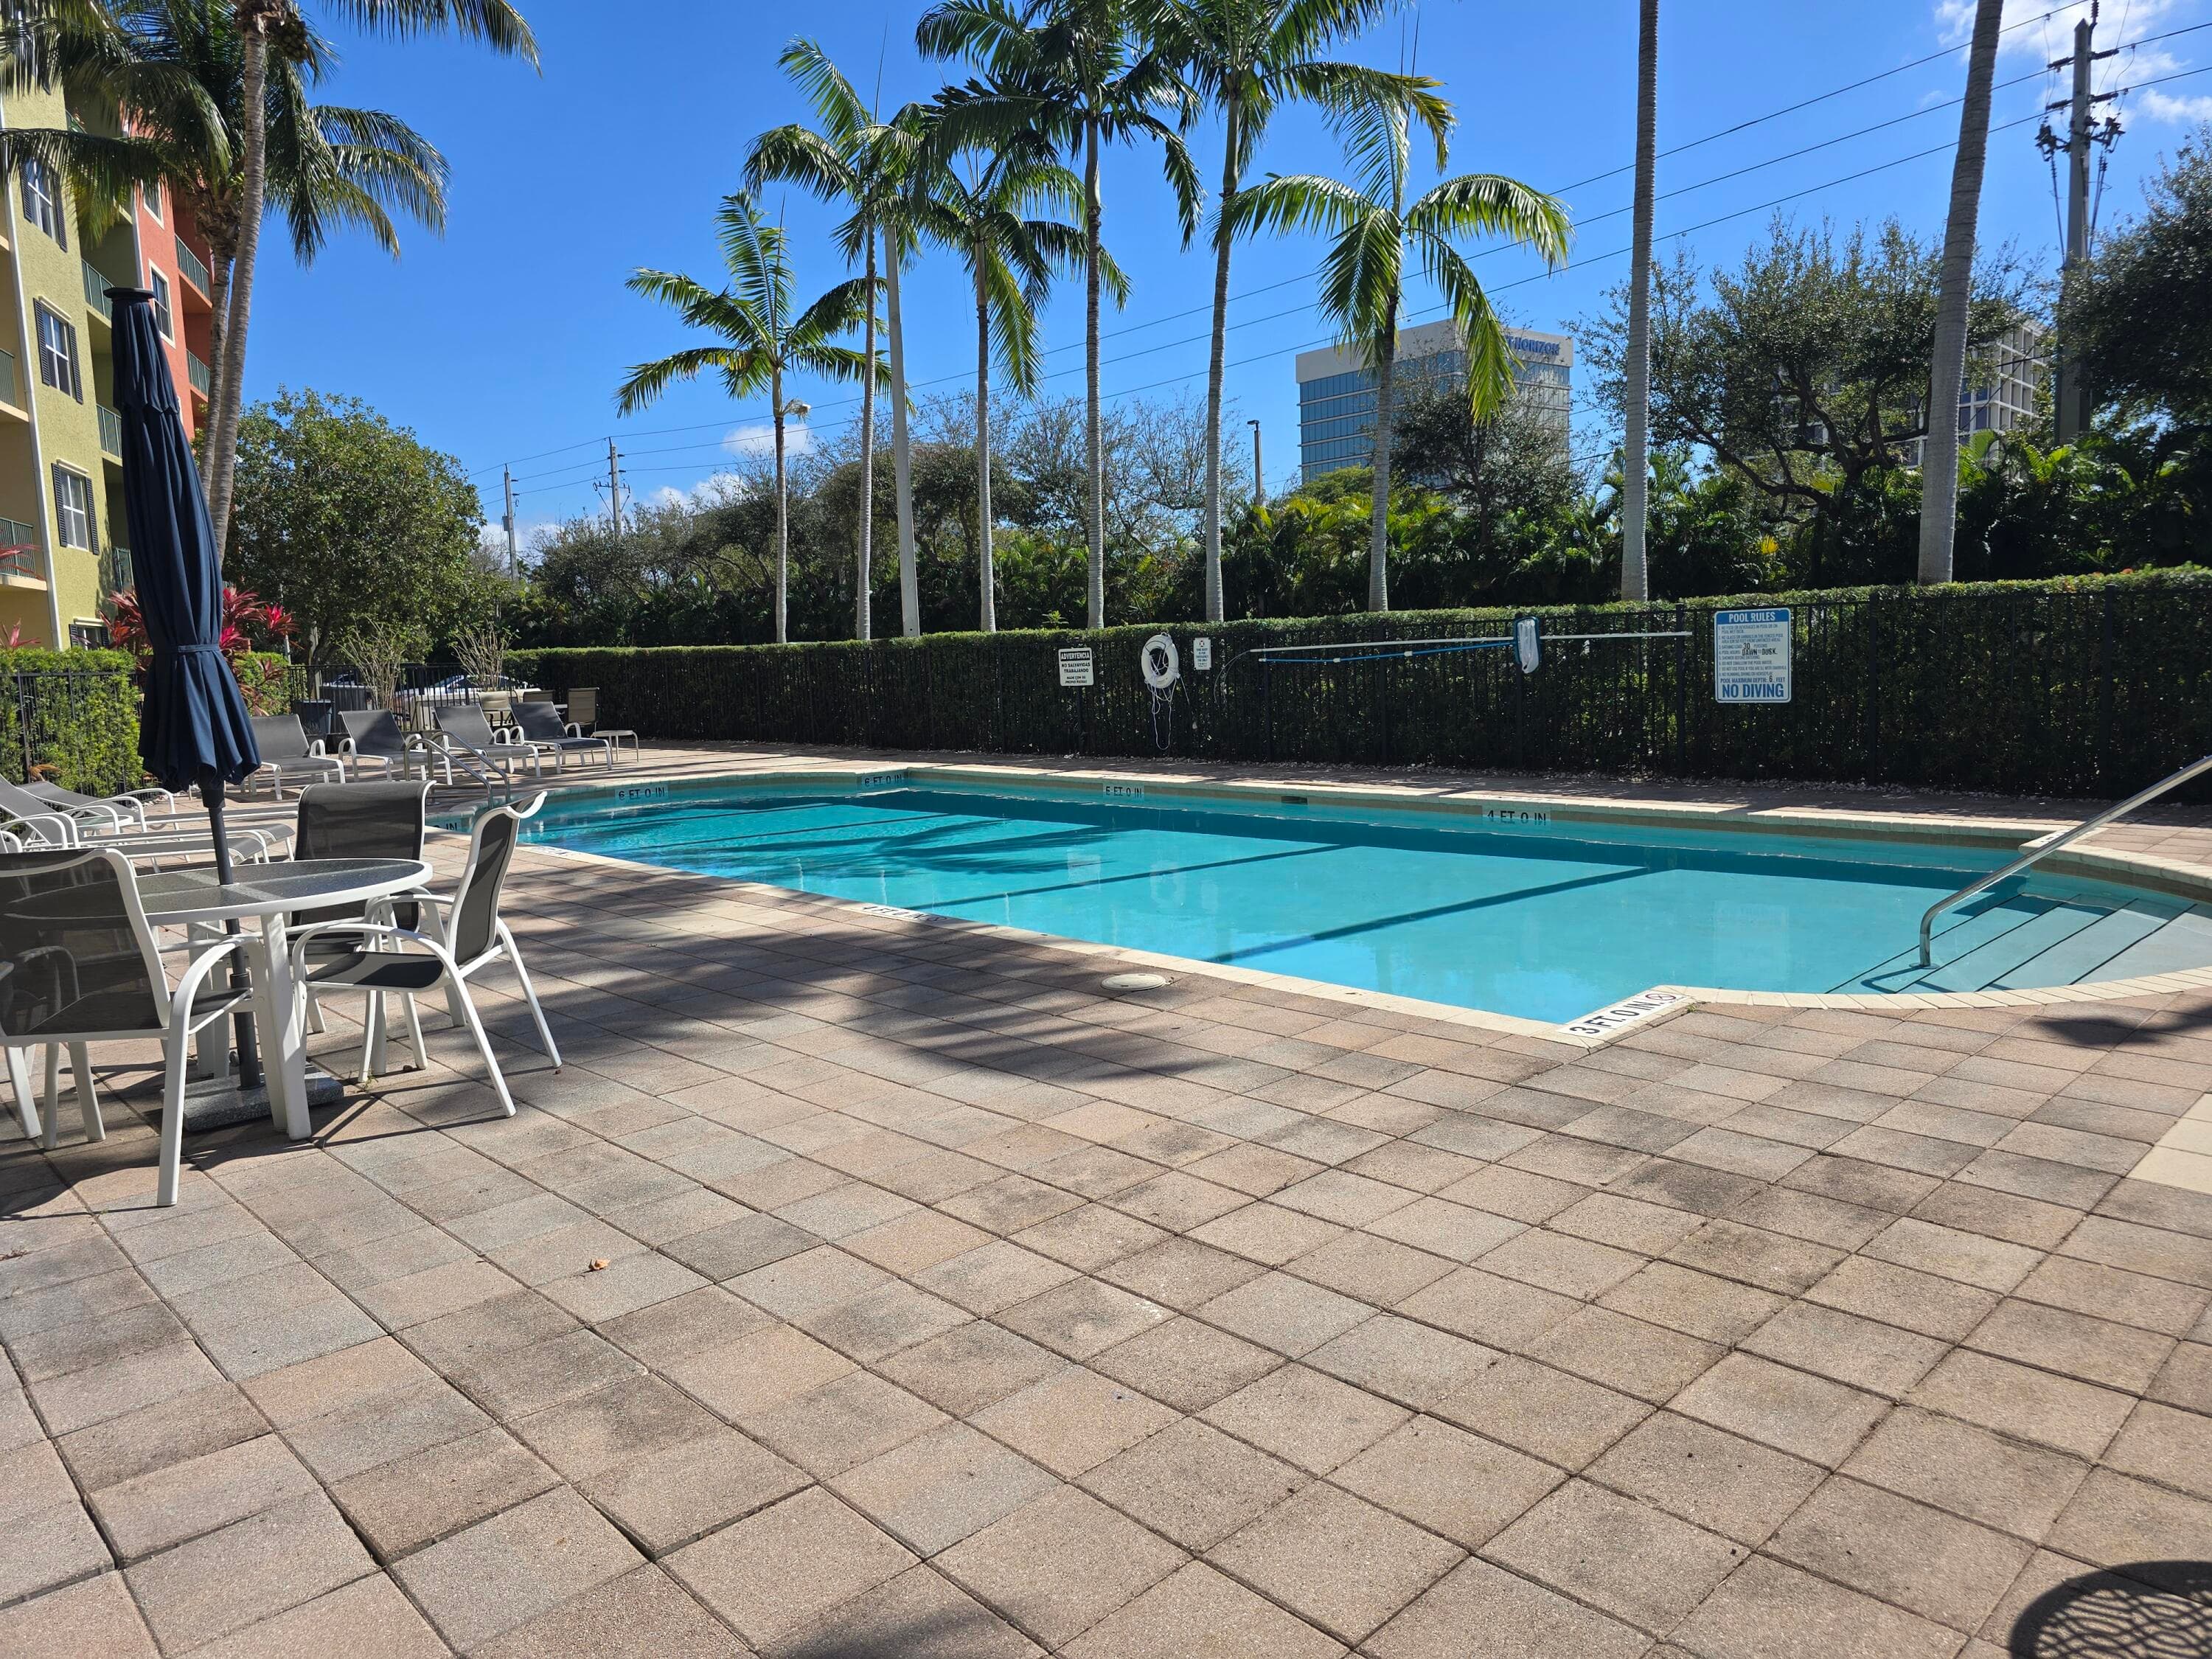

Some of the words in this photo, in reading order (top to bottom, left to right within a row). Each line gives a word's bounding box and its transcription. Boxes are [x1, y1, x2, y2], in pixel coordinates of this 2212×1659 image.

[1729, 613, 1749, 623] POOL
[1750, 612, 1775, 622] RULES
[1722, 684, 1739, 698] NO
[1743, 684, 1784, 698] DIVING
[895, 774, 902, 782] IN
[619, 790, 625, 800] 6
[655, 787, 664, 797] IN
[1135, 787, 1141, 797] IN
[1534, 813, 1545, 823] IN
[1583, 1015, 1627, 1027] FT.
[1623, 1001, 1663, 1010] IN.
